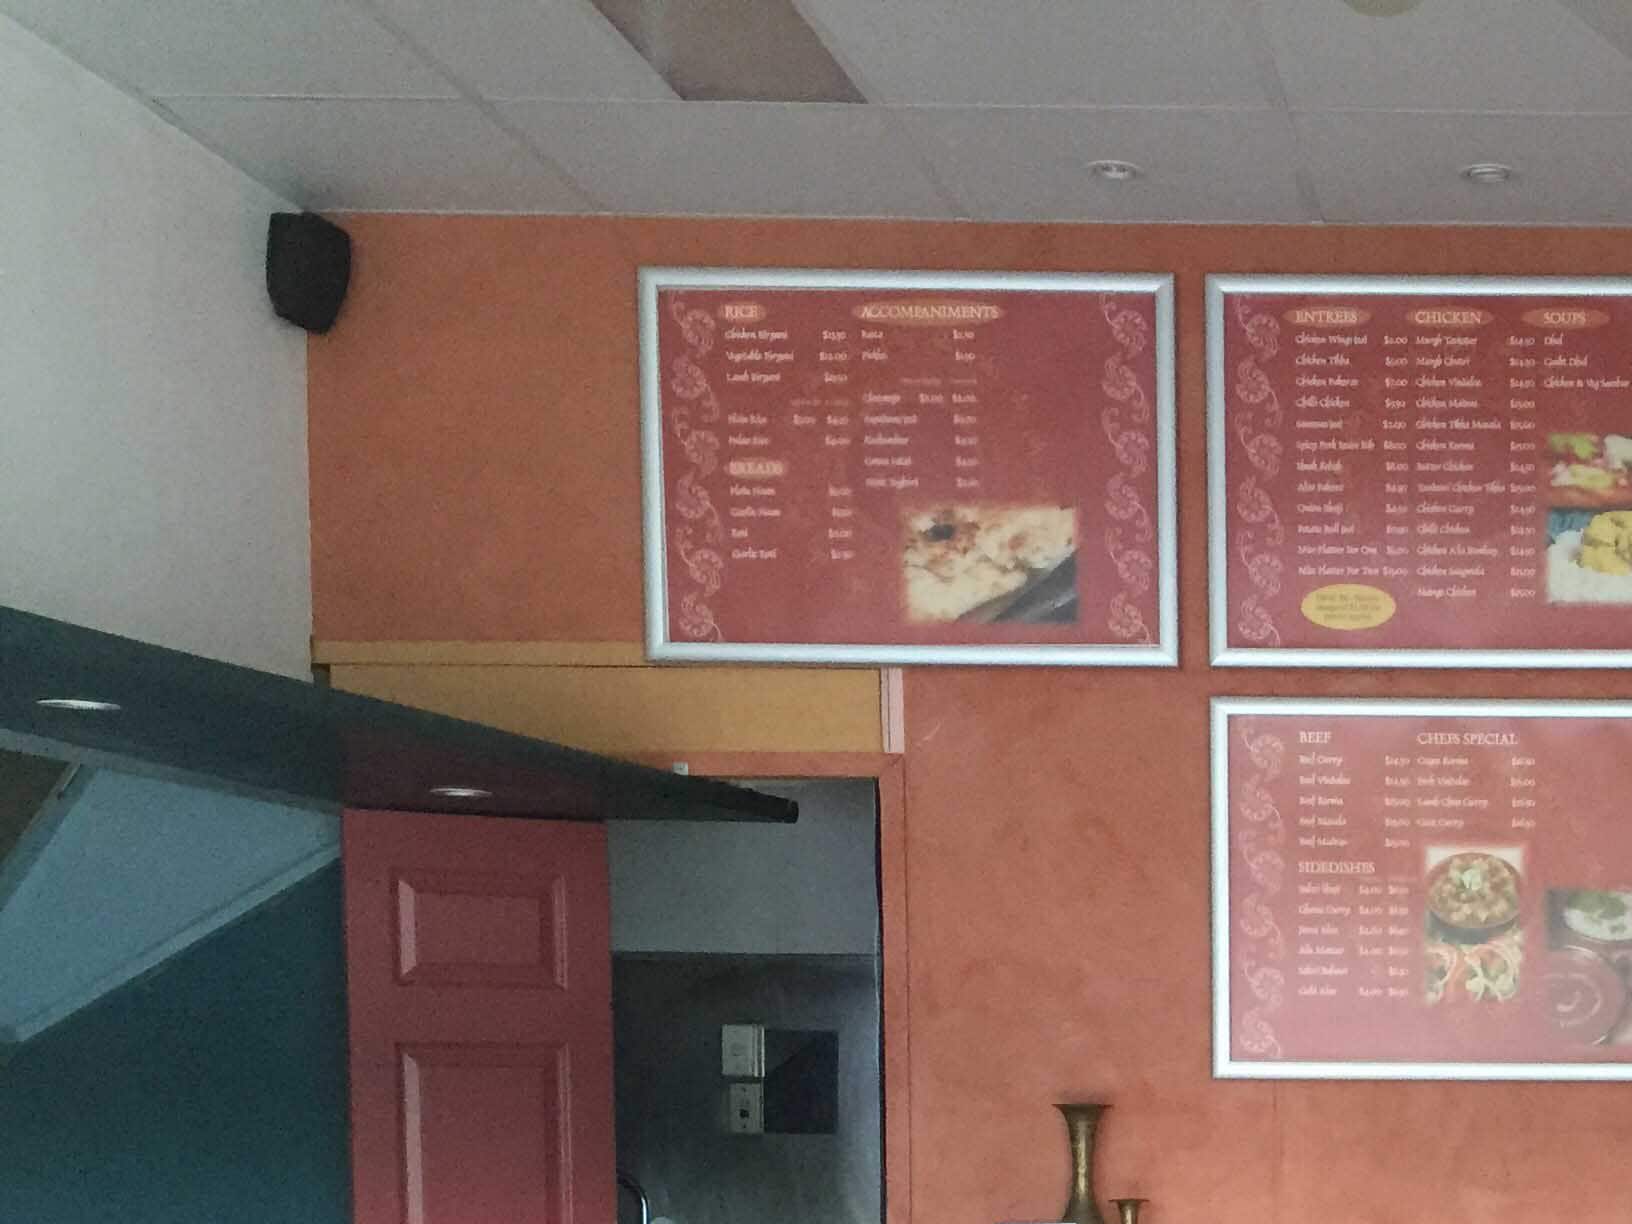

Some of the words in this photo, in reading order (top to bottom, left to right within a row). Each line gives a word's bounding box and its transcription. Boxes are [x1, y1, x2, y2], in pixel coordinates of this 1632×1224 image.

[725, 305, 758, 319] RICE
[861, 304, 999, 319] ACCOMPANIMENTS
[1415, 311, 1482, 324] CHICKEN
[1543, 311, 1586, 324] SOUPS
[1299, 731, 1332, 744] BEEF
[1462, 732, 1518, 745] SPECIAL
